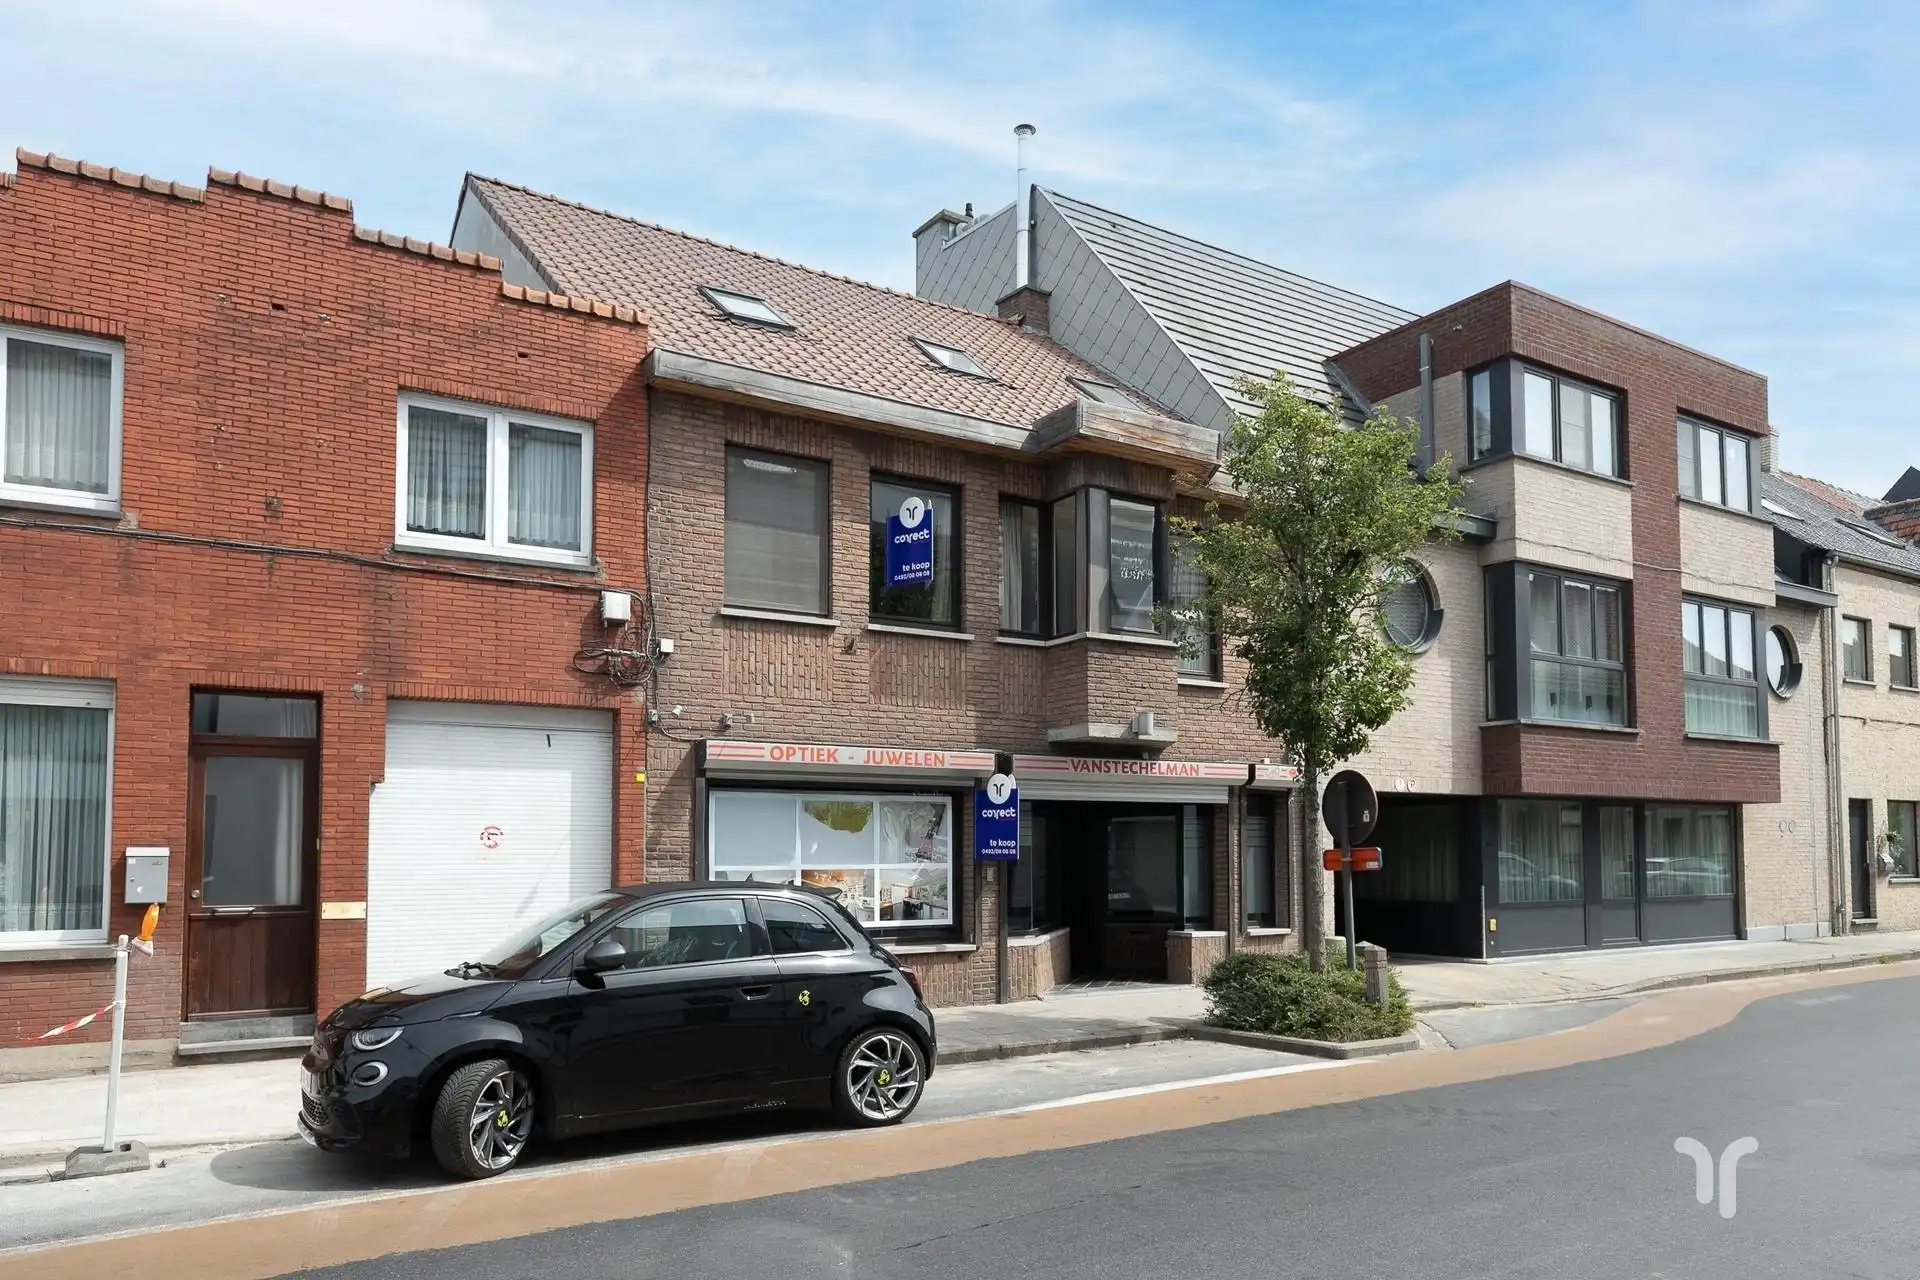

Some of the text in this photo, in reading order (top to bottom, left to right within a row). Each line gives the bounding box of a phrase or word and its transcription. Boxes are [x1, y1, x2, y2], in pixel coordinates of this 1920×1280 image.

[902, 561, 930, 572] te koop
[769, 746, 839, 763] OPTIEK
[863, 750, 945, 767] JUWELEN
[1070, 759, 1200, 776] VANSTECHELMAN
[989, 838, 1016, 848] te koop
